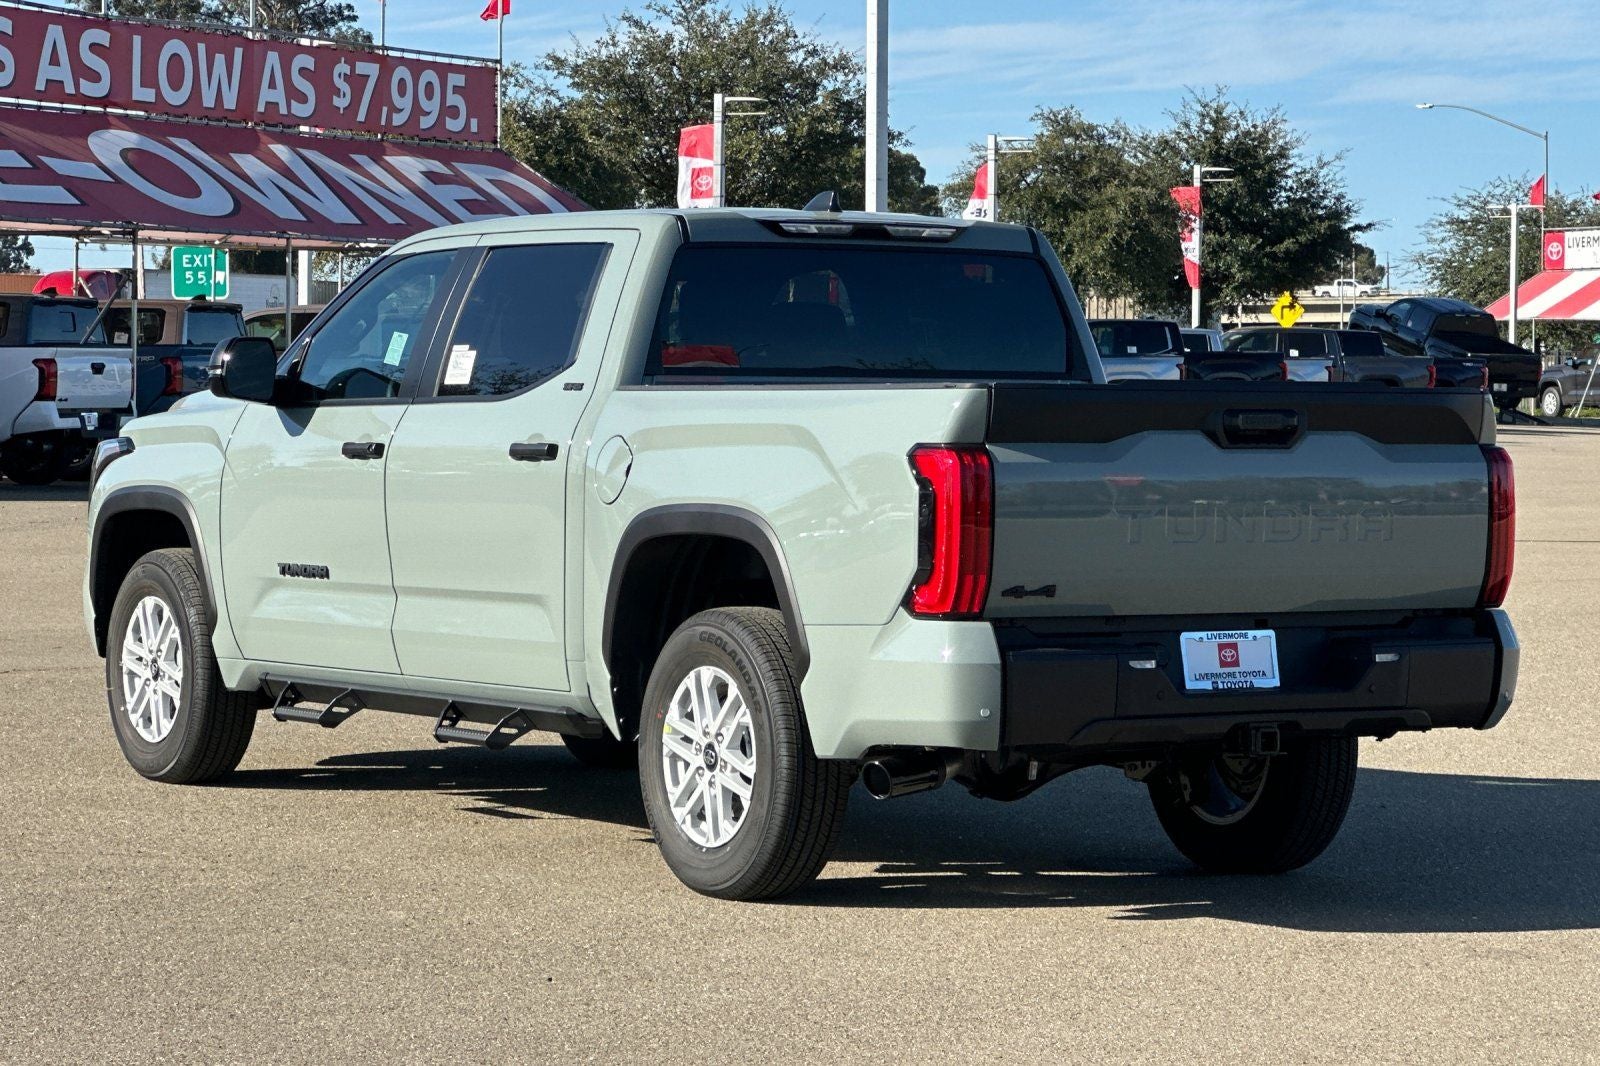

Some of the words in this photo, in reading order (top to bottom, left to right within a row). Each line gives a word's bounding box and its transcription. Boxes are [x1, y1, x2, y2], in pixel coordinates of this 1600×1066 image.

[35, 24, 111, 98] AS
[132, 35, 243, 110] LOW
[257, 51, 316, 118] AS
[1112, 502, 1394, 543] TUNDRA
[277, 562, 330, 580] TUNDRA
[1206, 632, 1249, 640] LIVERMORE
[1194, 672, 1238, 681] LIVERMORE
[1238, 670, 1267, 678] TOYOTA
[1222, 680, 1255, 688] TOYOTA
